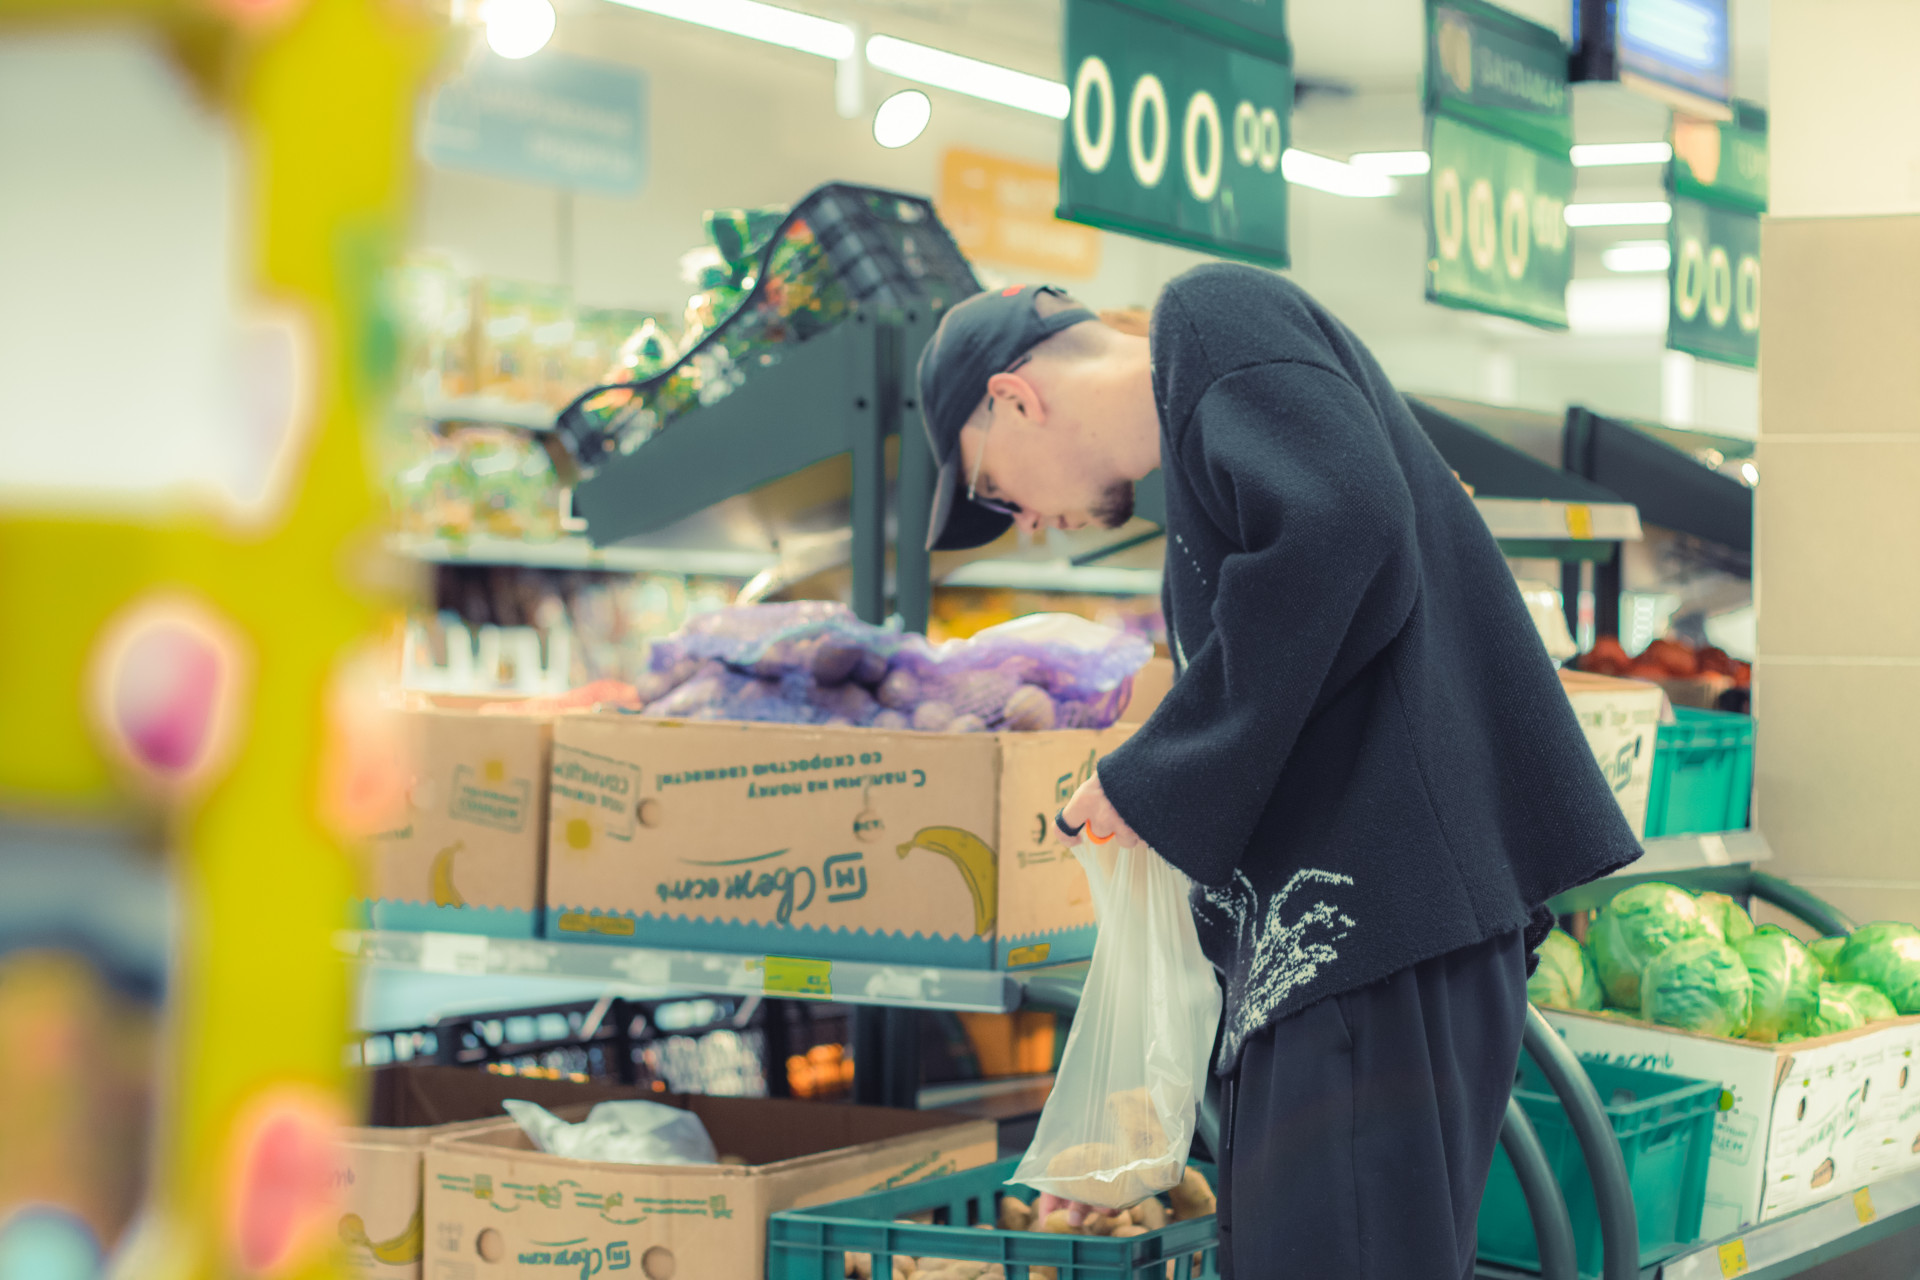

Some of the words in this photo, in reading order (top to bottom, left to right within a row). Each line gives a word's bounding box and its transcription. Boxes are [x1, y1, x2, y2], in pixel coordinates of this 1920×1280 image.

[751, 753, 855, 776] скоростью
[859, 752, 883, 766] со
[833, 772, 906, 793] палмы
[911, 768, 927, 788] С
[748, 782, 803, 801] полку
[807, 780, 829, 796] на
